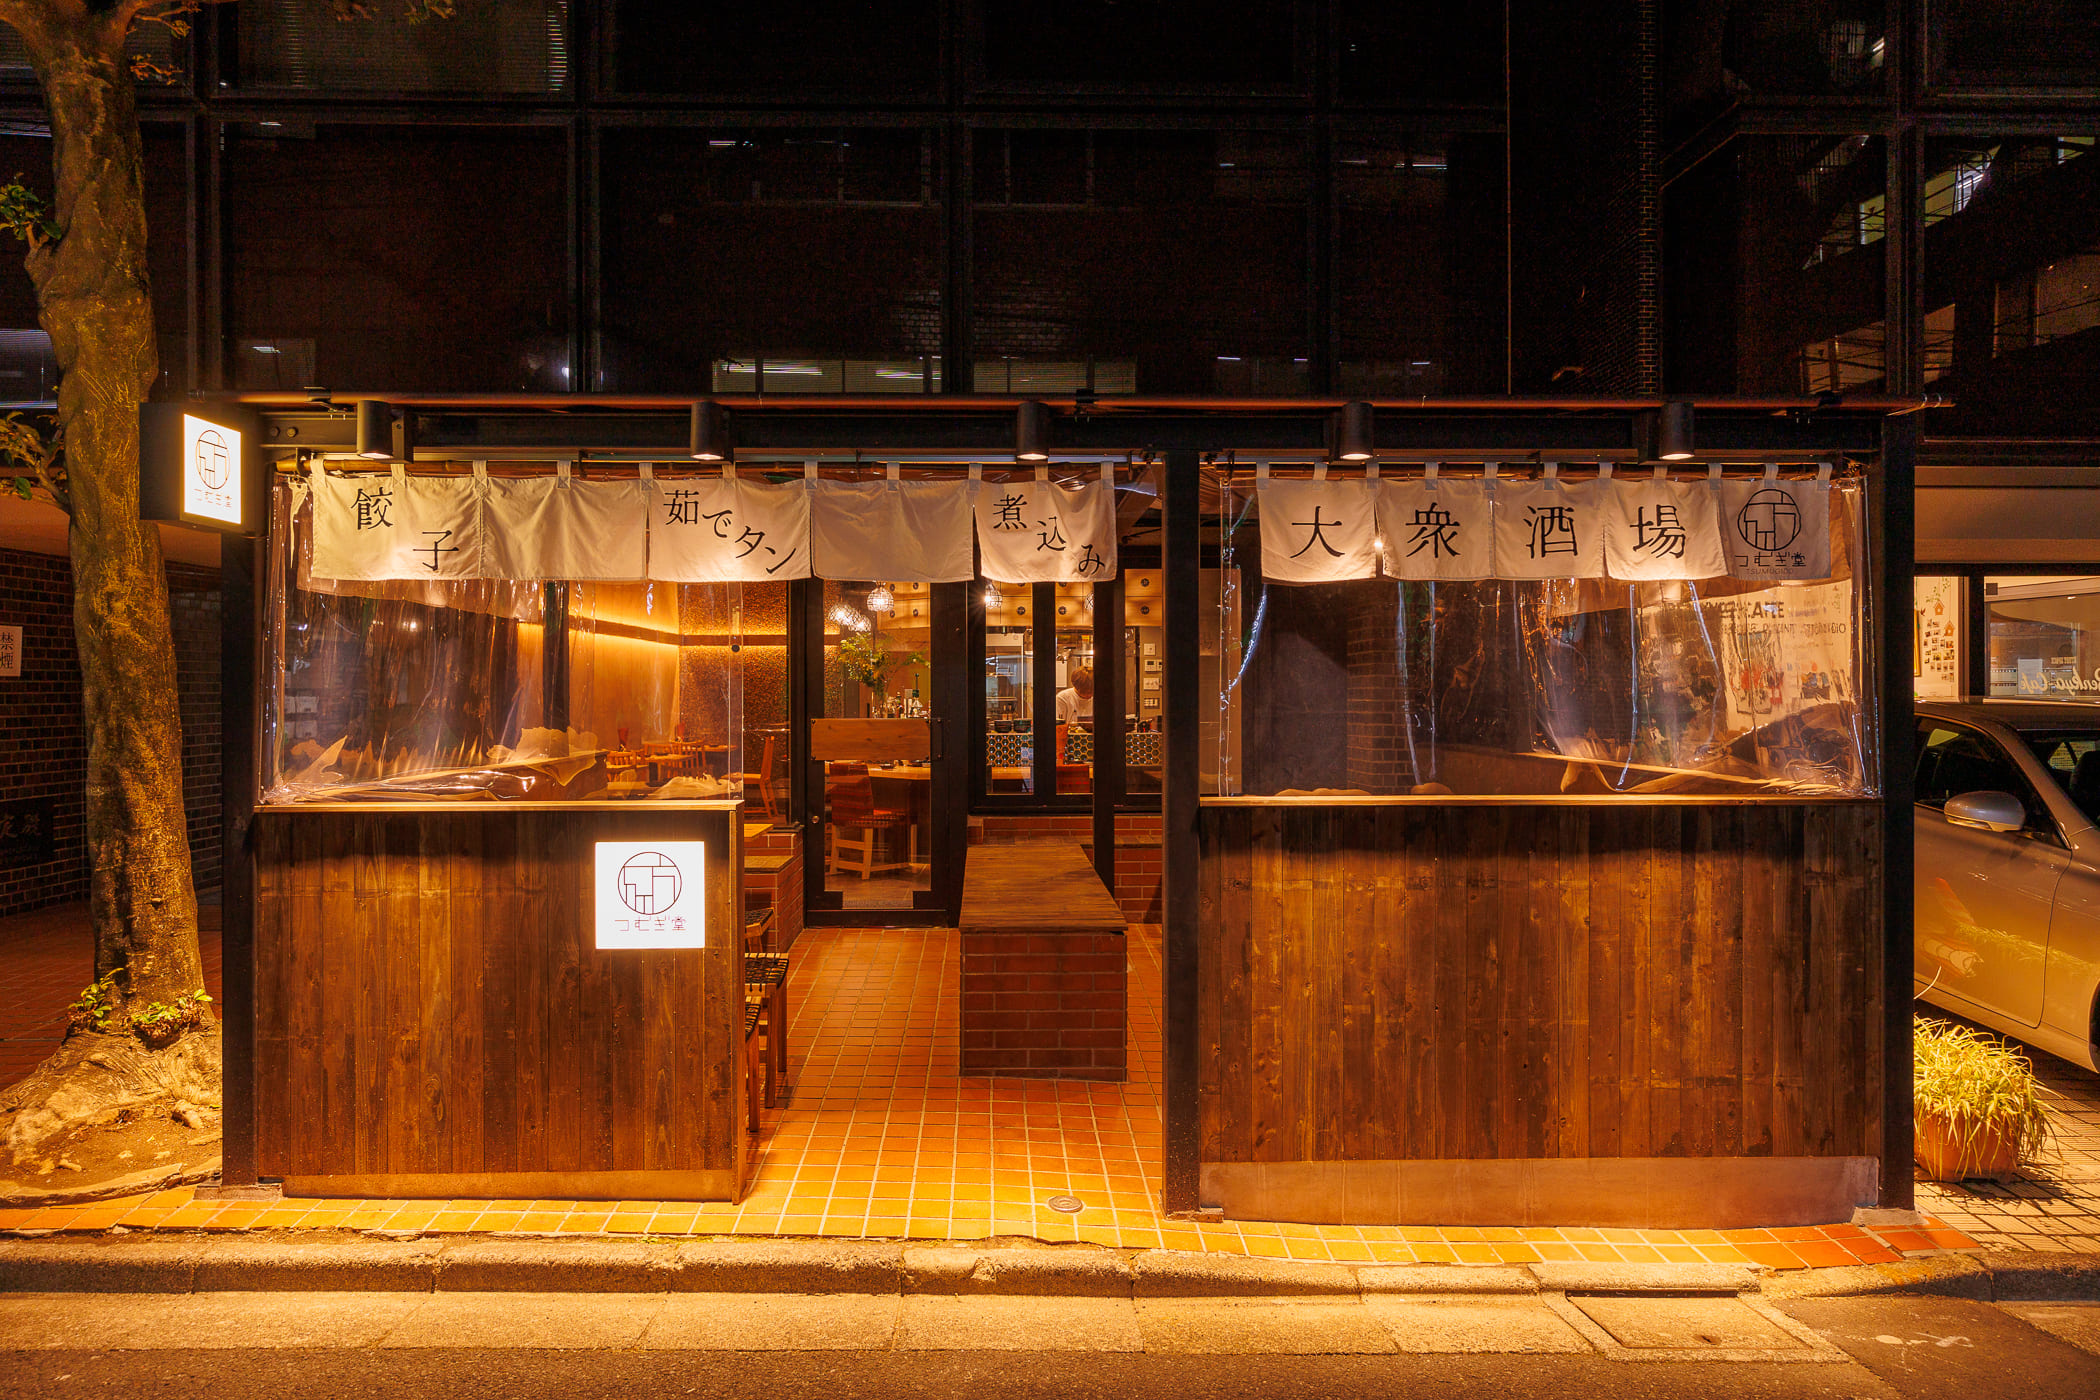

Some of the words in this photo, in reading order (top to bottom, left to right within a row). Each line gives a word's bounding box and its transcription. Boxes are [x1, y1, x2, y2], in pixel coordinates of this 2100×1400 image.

[351, 486, 459, 571] 餃子
[663, 490, 797, 574] 茹でタン
[993, 494, 1105, 575] 煮込み
[1290, 503, 1686, 559] 大衆酒場
[1734, 552, 1807, 567] つむぎ堂
[614, 914, 687, 932] つむぎ堂
